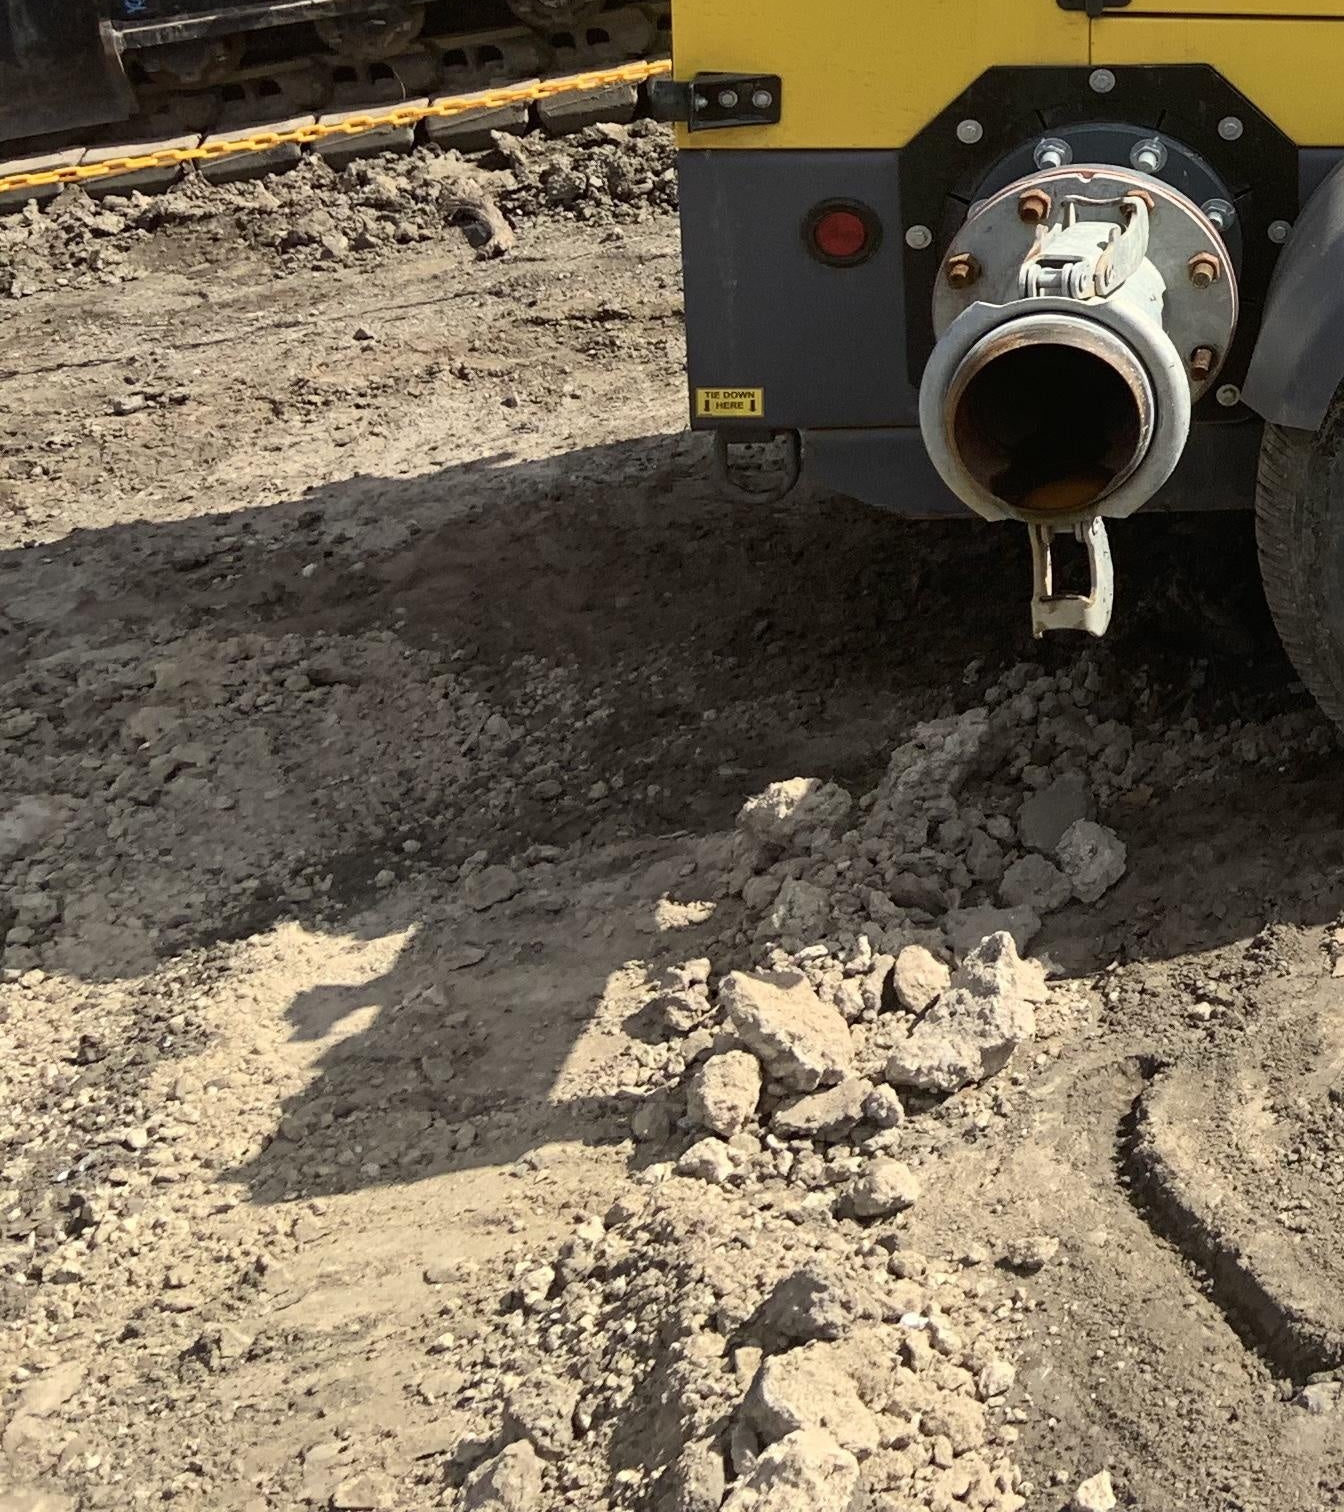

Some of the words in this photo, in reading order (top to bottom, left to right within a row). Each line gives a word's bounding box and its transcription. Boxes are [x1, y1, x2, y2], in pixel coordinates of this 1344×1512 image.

[705, 391, 720, 399] TIE
[723, 391, 755, 399] DOWN
[716, 401, 744, 409] HERE
